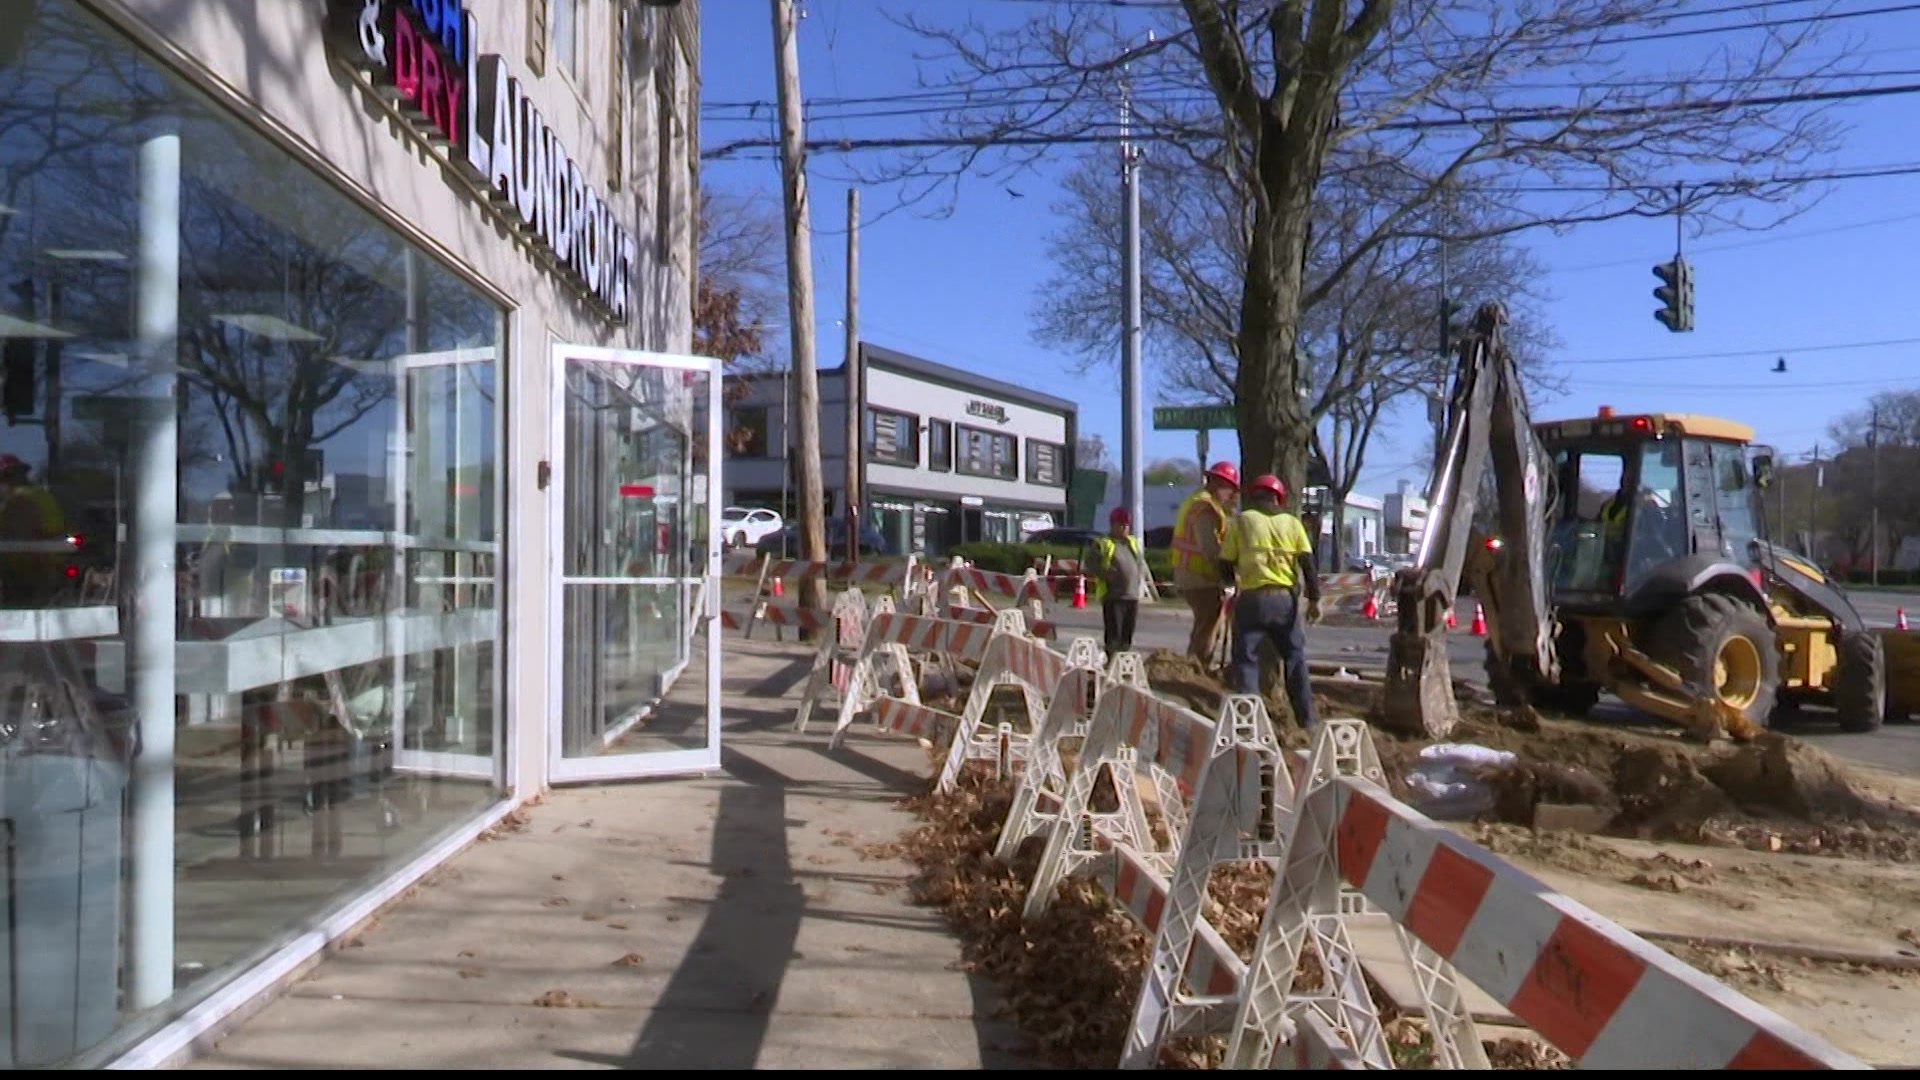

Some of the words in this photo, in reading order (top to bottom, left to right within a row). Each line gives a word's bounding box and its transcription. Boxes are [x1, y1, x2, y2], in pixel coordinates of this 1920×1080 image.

[359, 0, 388, 66] &
[395, 6, 460, 142] DRY
[467, 10, 635, 322] LAUNDROMAT
